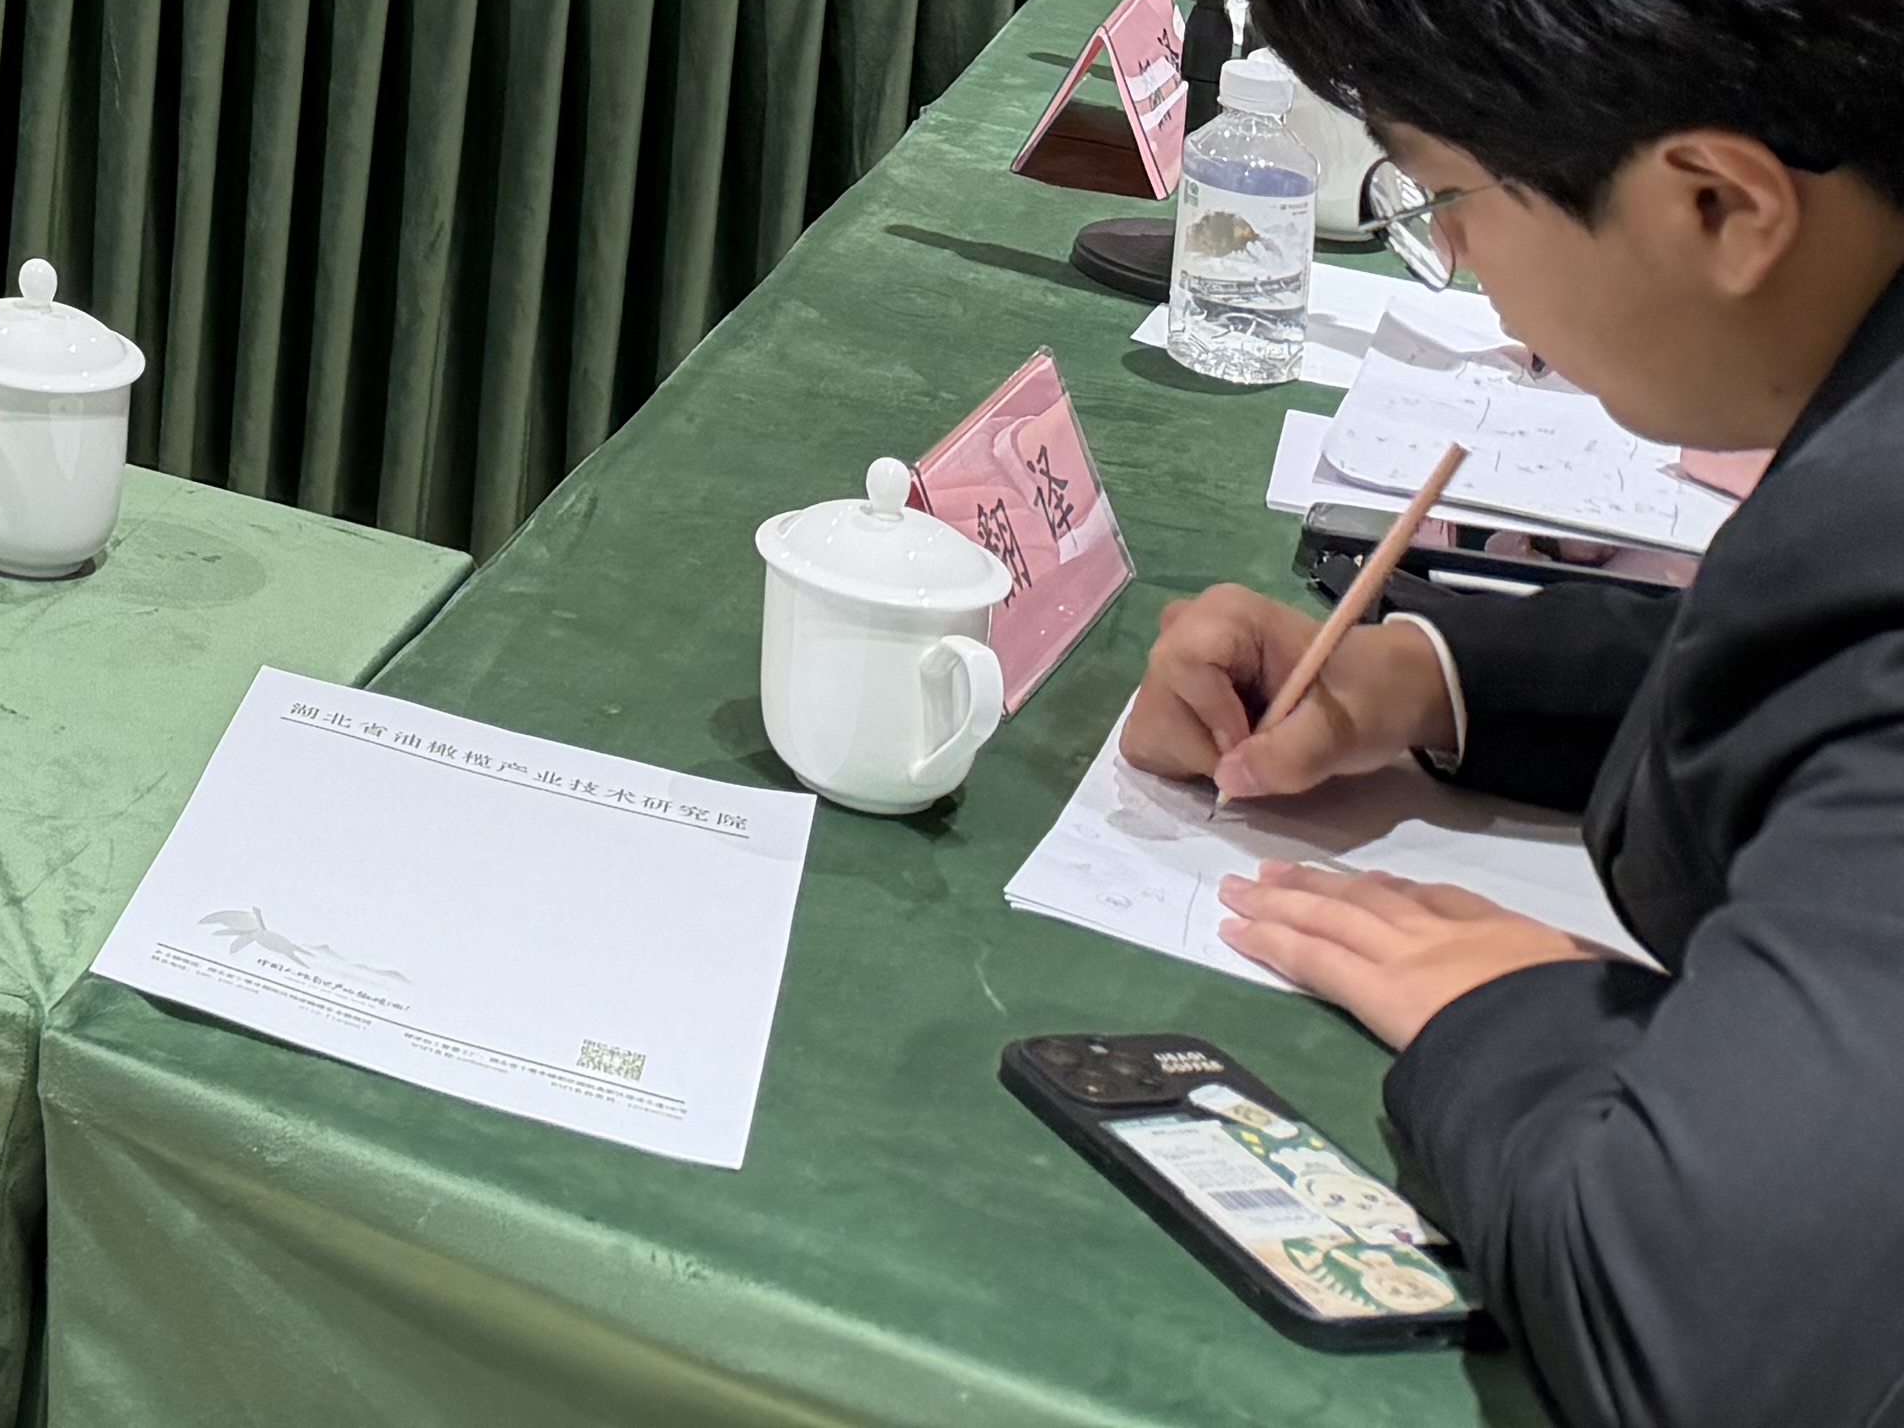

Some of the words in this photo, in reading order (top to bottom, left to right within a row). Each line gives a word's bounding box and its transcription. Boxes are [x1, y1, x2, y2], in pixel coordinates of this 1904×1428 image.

[290, 701, 749, 832] 湖北省油橄榄产业技术研究院
